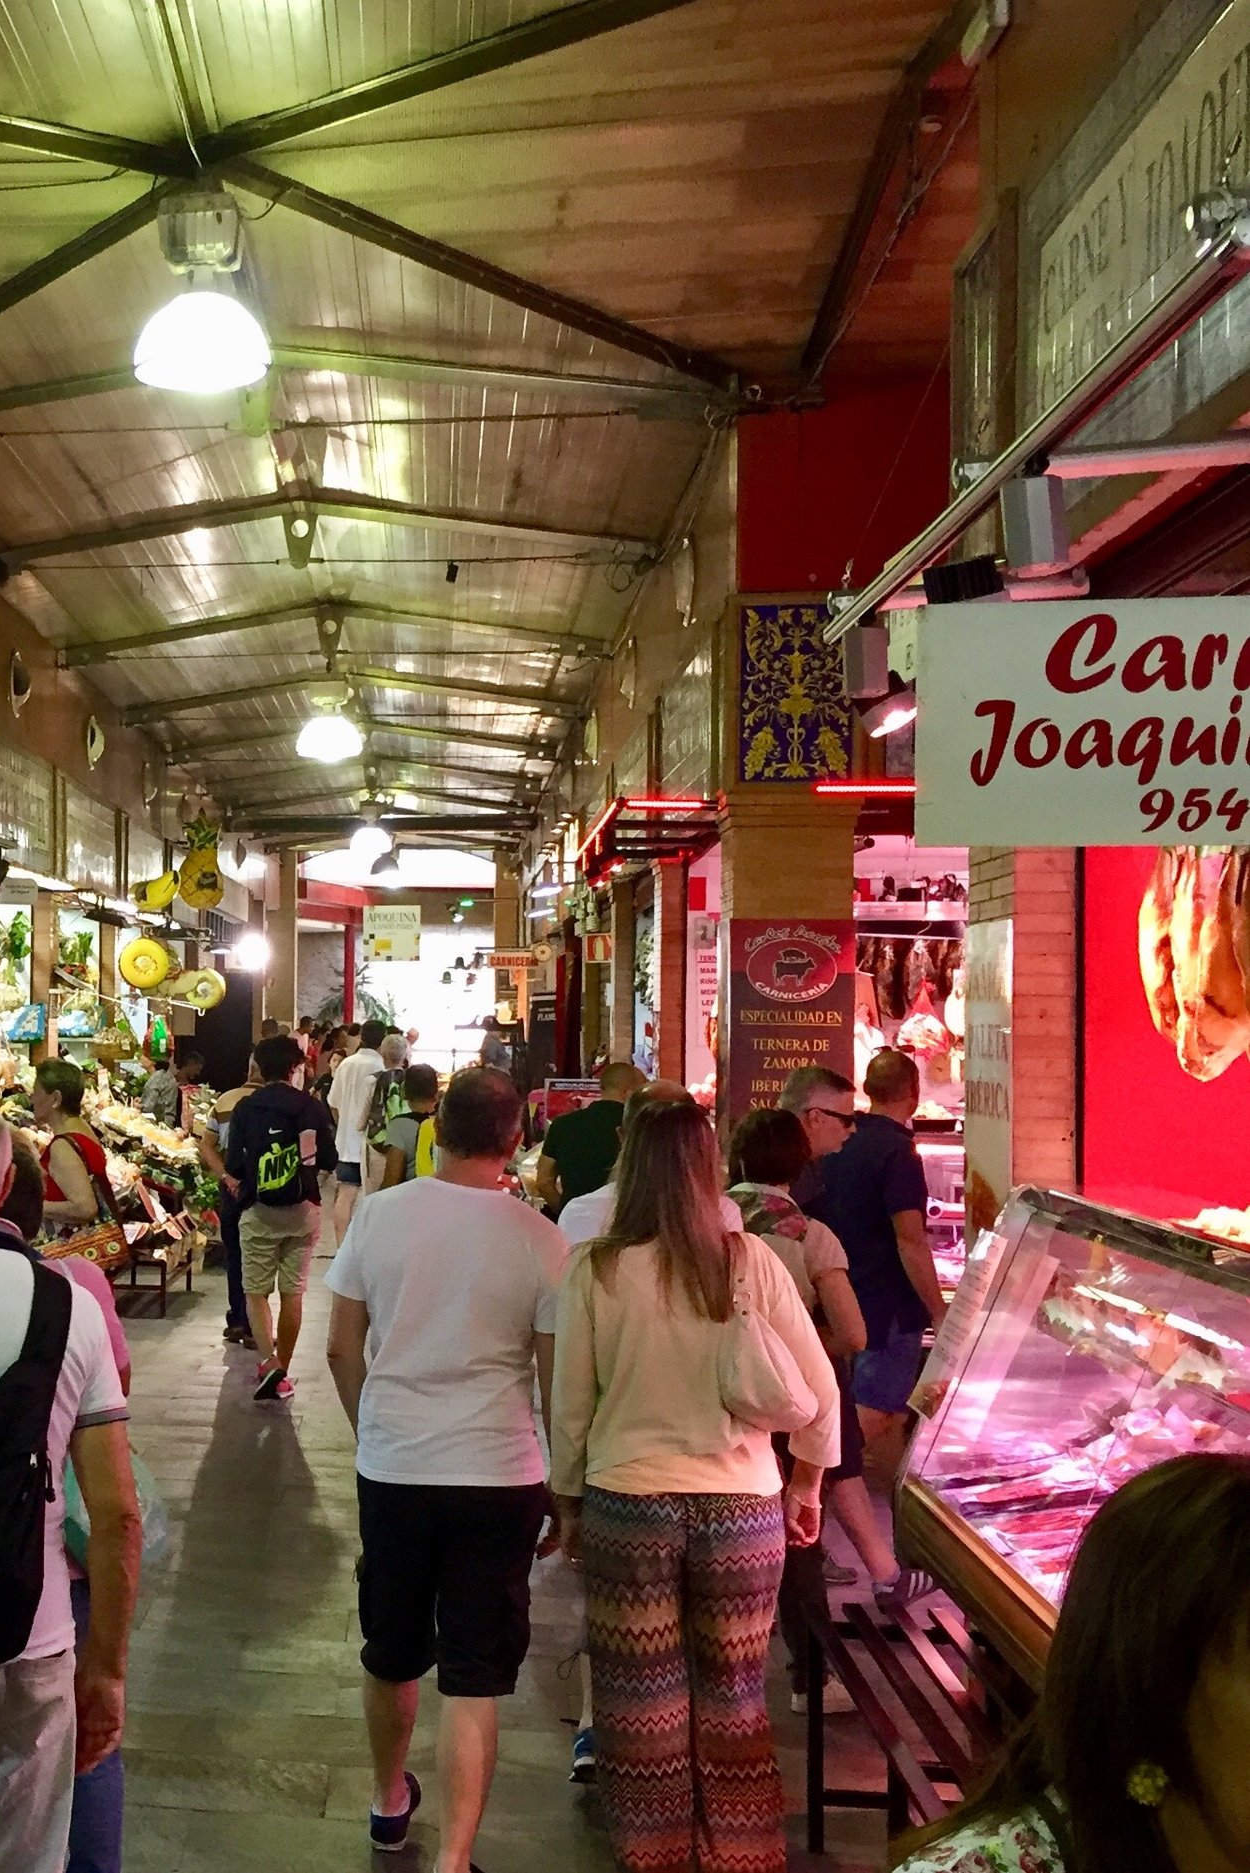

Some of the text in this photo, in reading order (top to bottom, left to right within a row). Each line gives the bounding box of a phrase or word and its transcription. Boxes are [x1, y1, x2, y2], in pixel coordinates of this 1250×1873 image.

[970, 695, 1250, 786] Joaqui
[740, 1010, 843, 1024] ESPECIALIDAD EN
[753, 1038, 830, 1051] TERNERA DE
